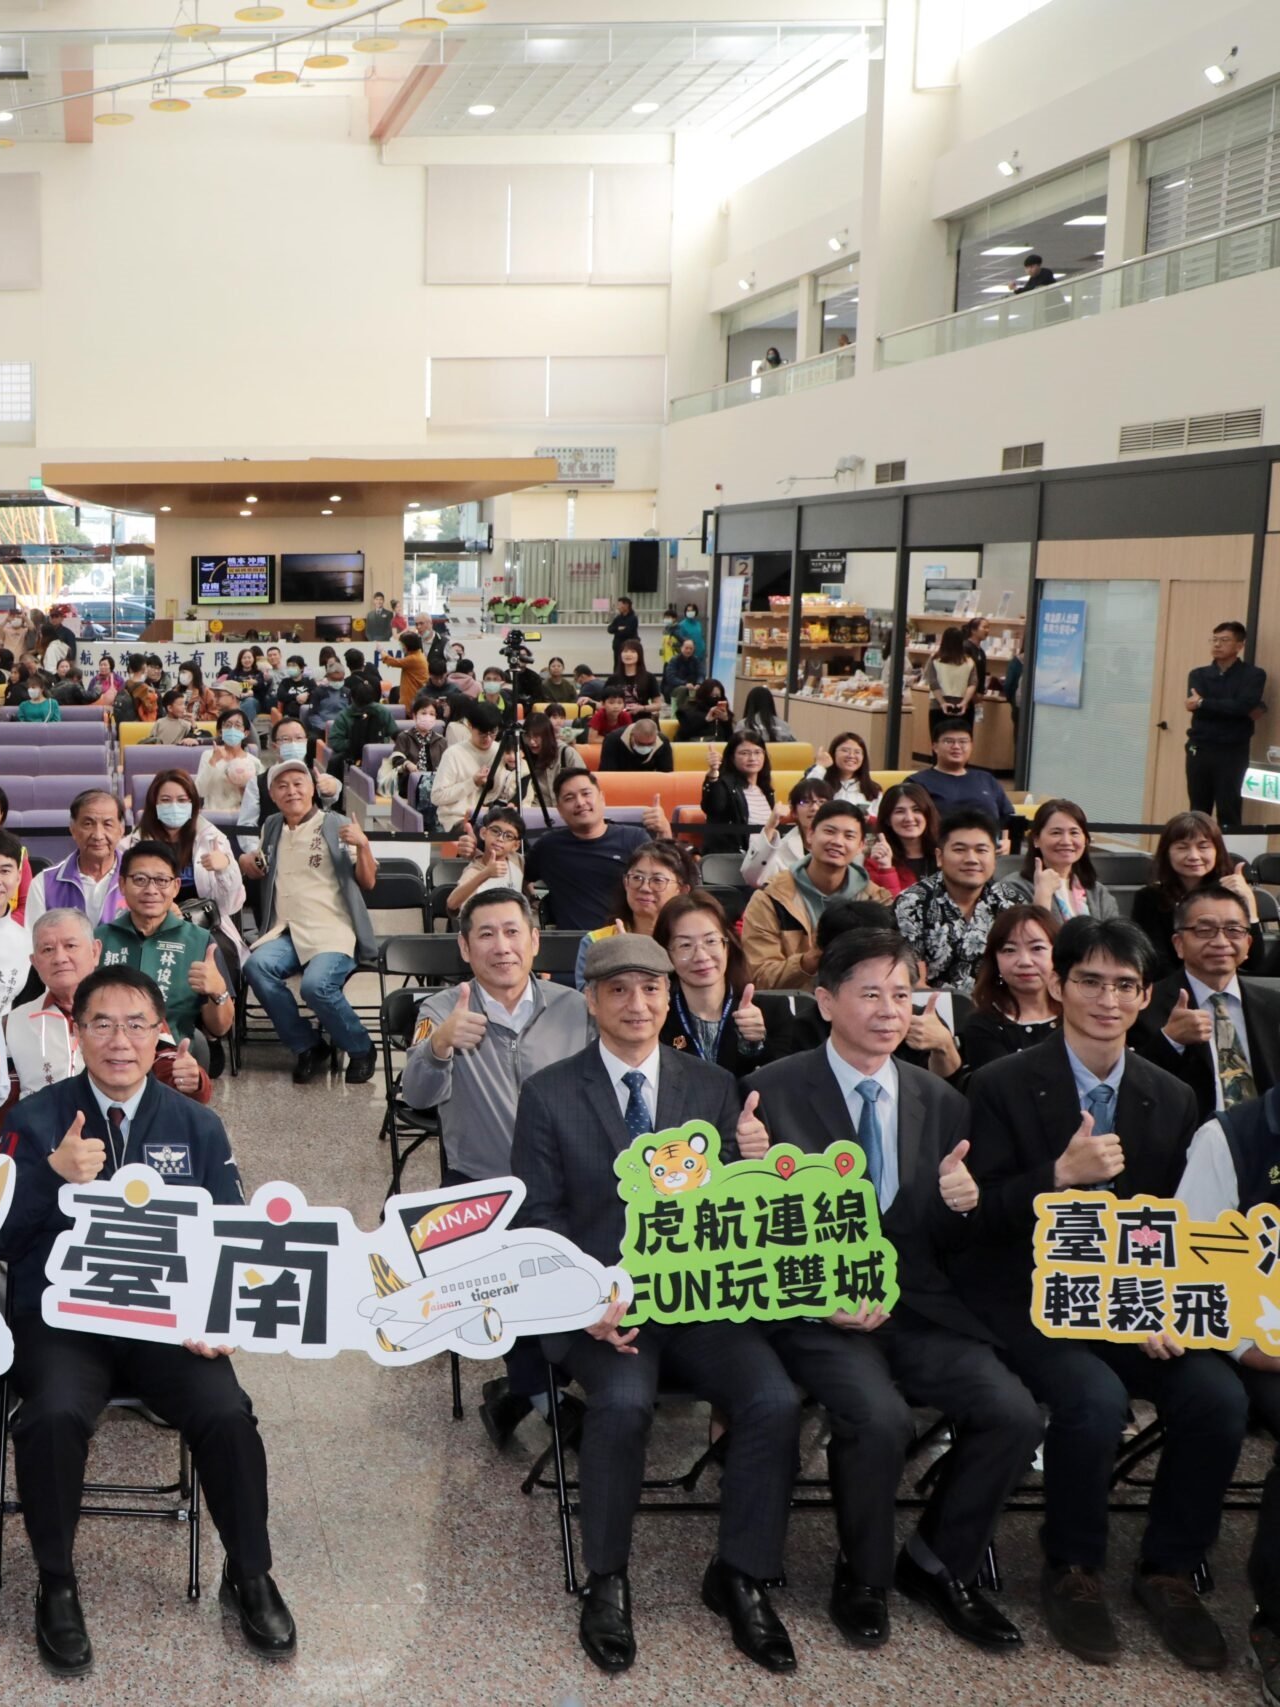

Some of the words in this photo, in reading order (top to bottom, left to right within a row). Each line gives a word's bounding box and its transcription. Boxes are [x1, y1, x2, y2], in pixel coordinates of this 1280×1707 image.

[410, 1200, 492, 1240] TAINAN
[634, 1189, 870, 1256] 虎航連線
[1046, 1202, 1177, 1268] 臺南
[58, 1190, 339, 1345] 臺南
[625, 1250, 888, 1316] FUN玩雙城
[1043, 1272, 1231, 1339] 輕鬆飛
